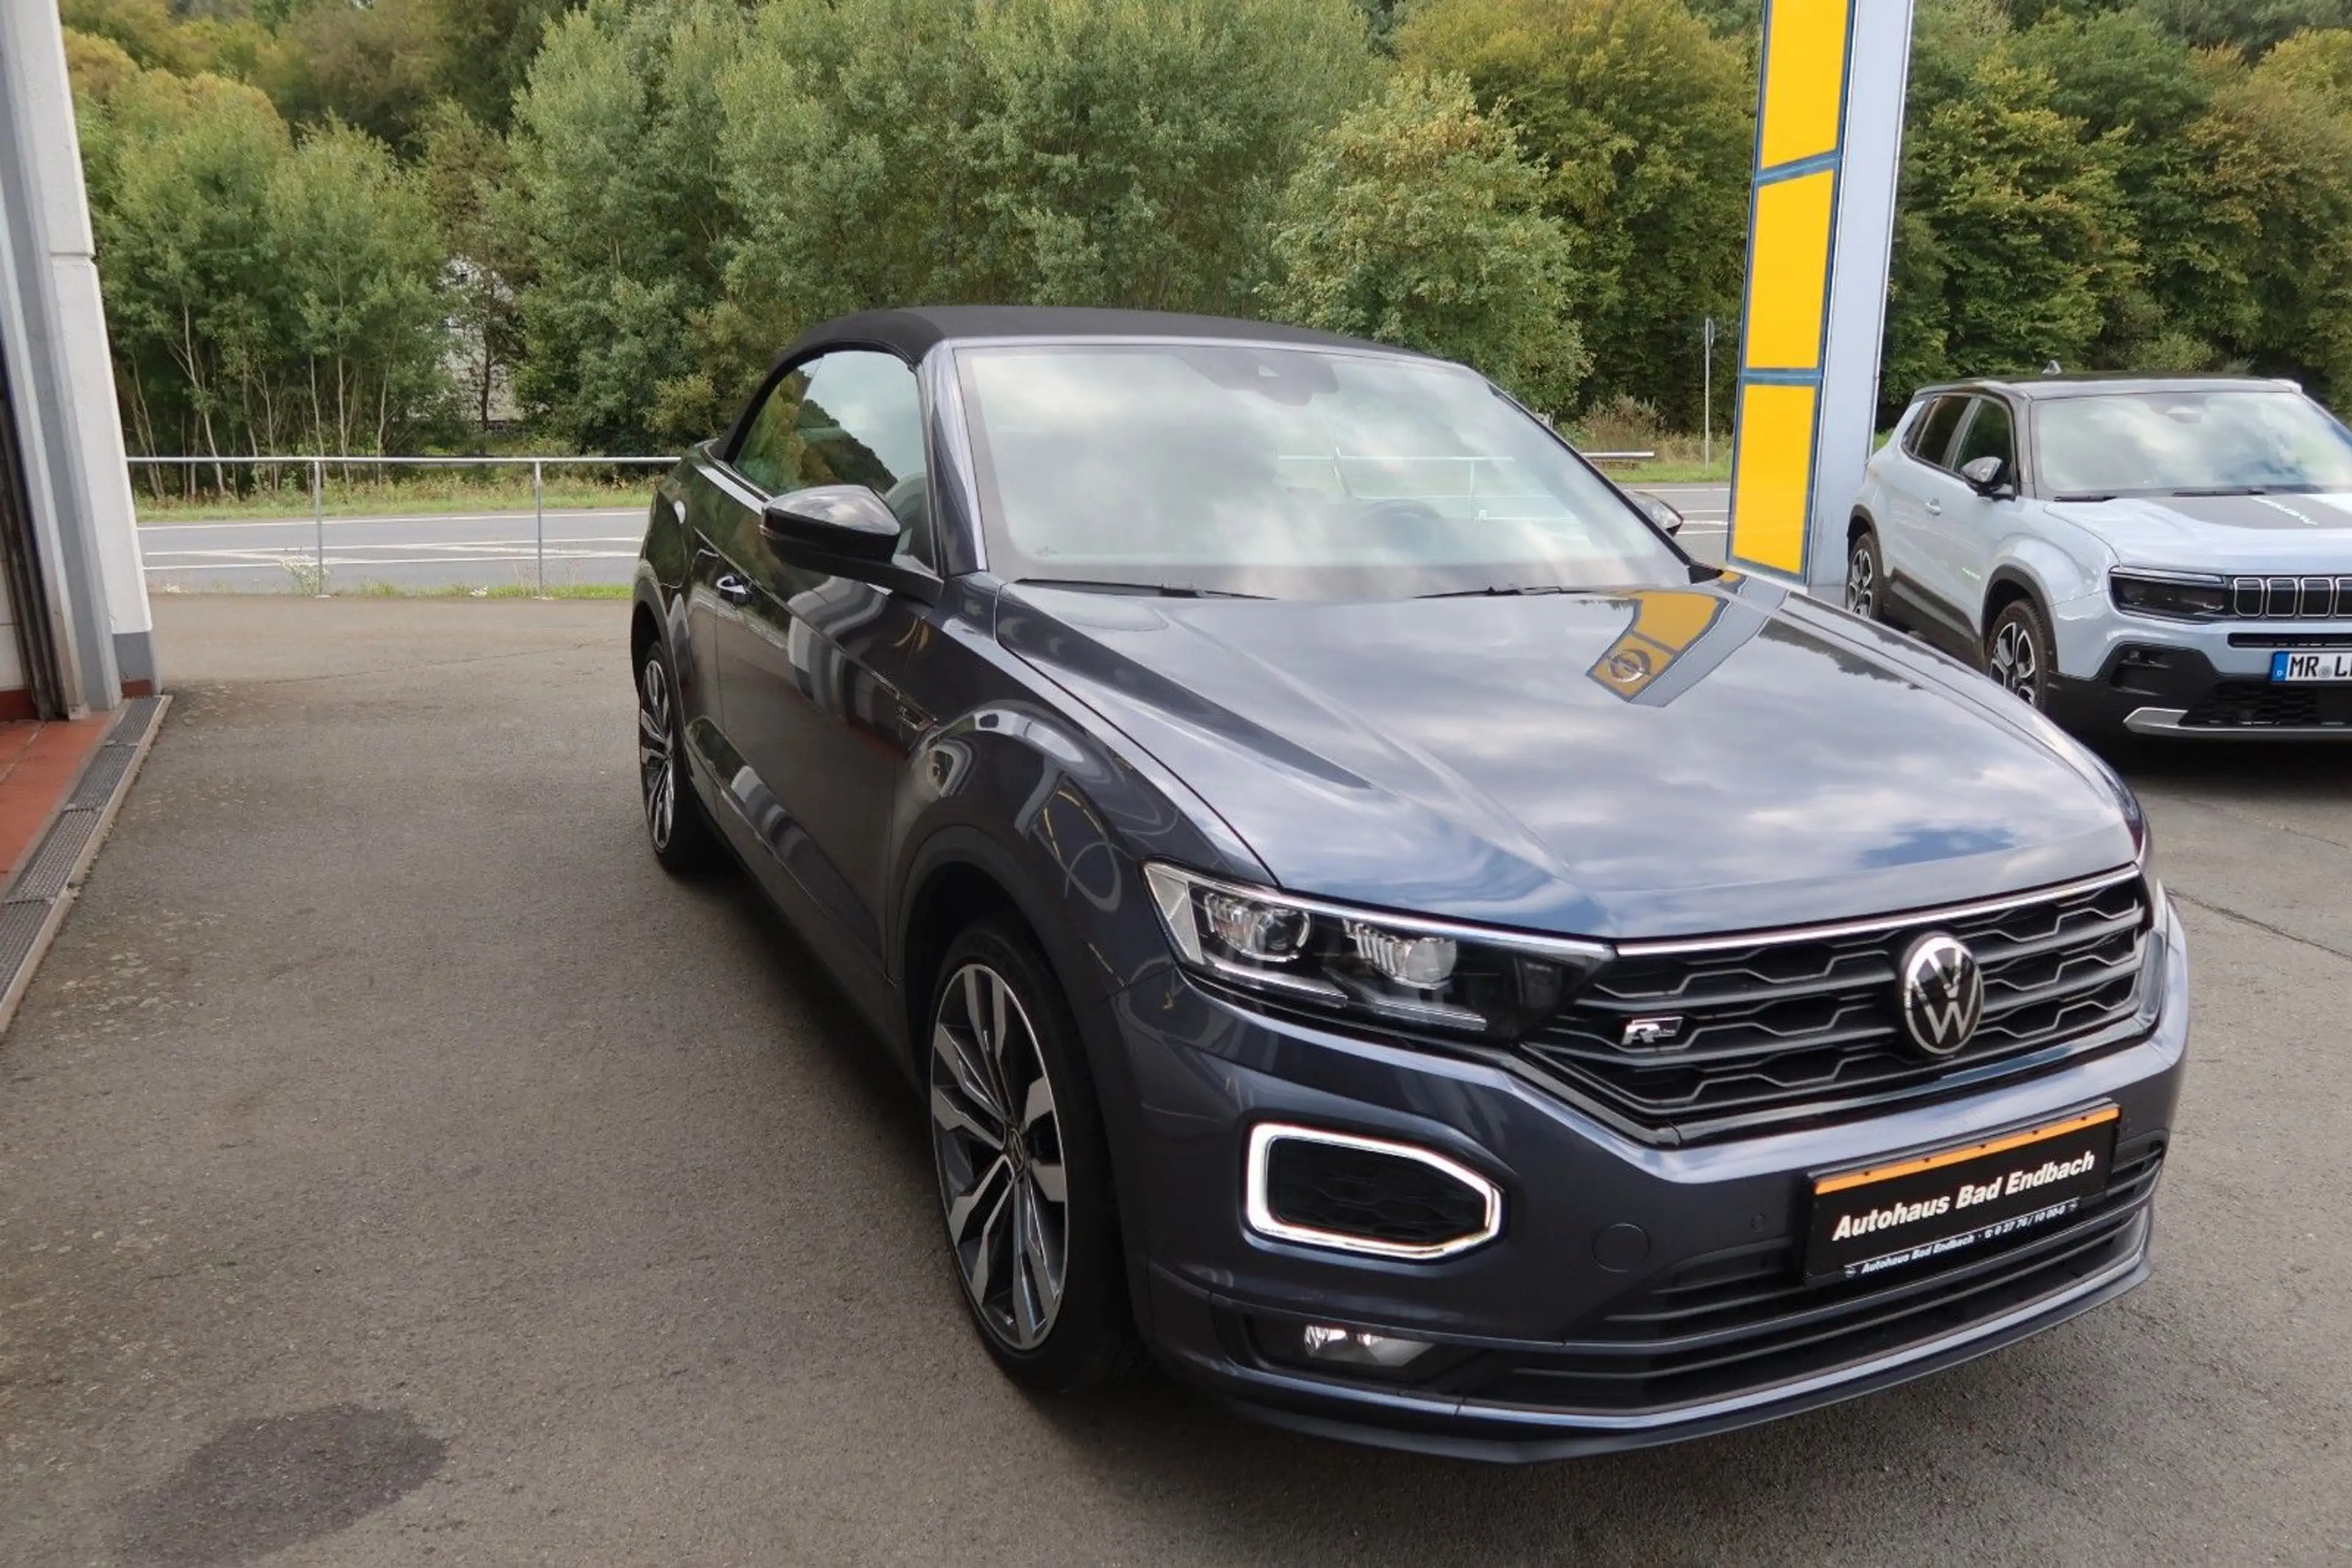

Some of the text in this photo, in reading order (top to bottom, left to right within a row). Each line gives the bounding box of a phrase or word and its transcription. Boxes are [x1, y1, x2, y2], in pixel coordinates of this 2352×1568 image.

[2290, 655, 2320, 677] MR
[2334, 655, 2352, 677] L
[1832, 1150, 2095, 1242] Autohaus Bad Endbach
[1861, 1254, 1910, 1274] Autohaus
[1911, 1245, 1932, 1260] Bad
[1933, 1234, 1975, 1254] Endbach
